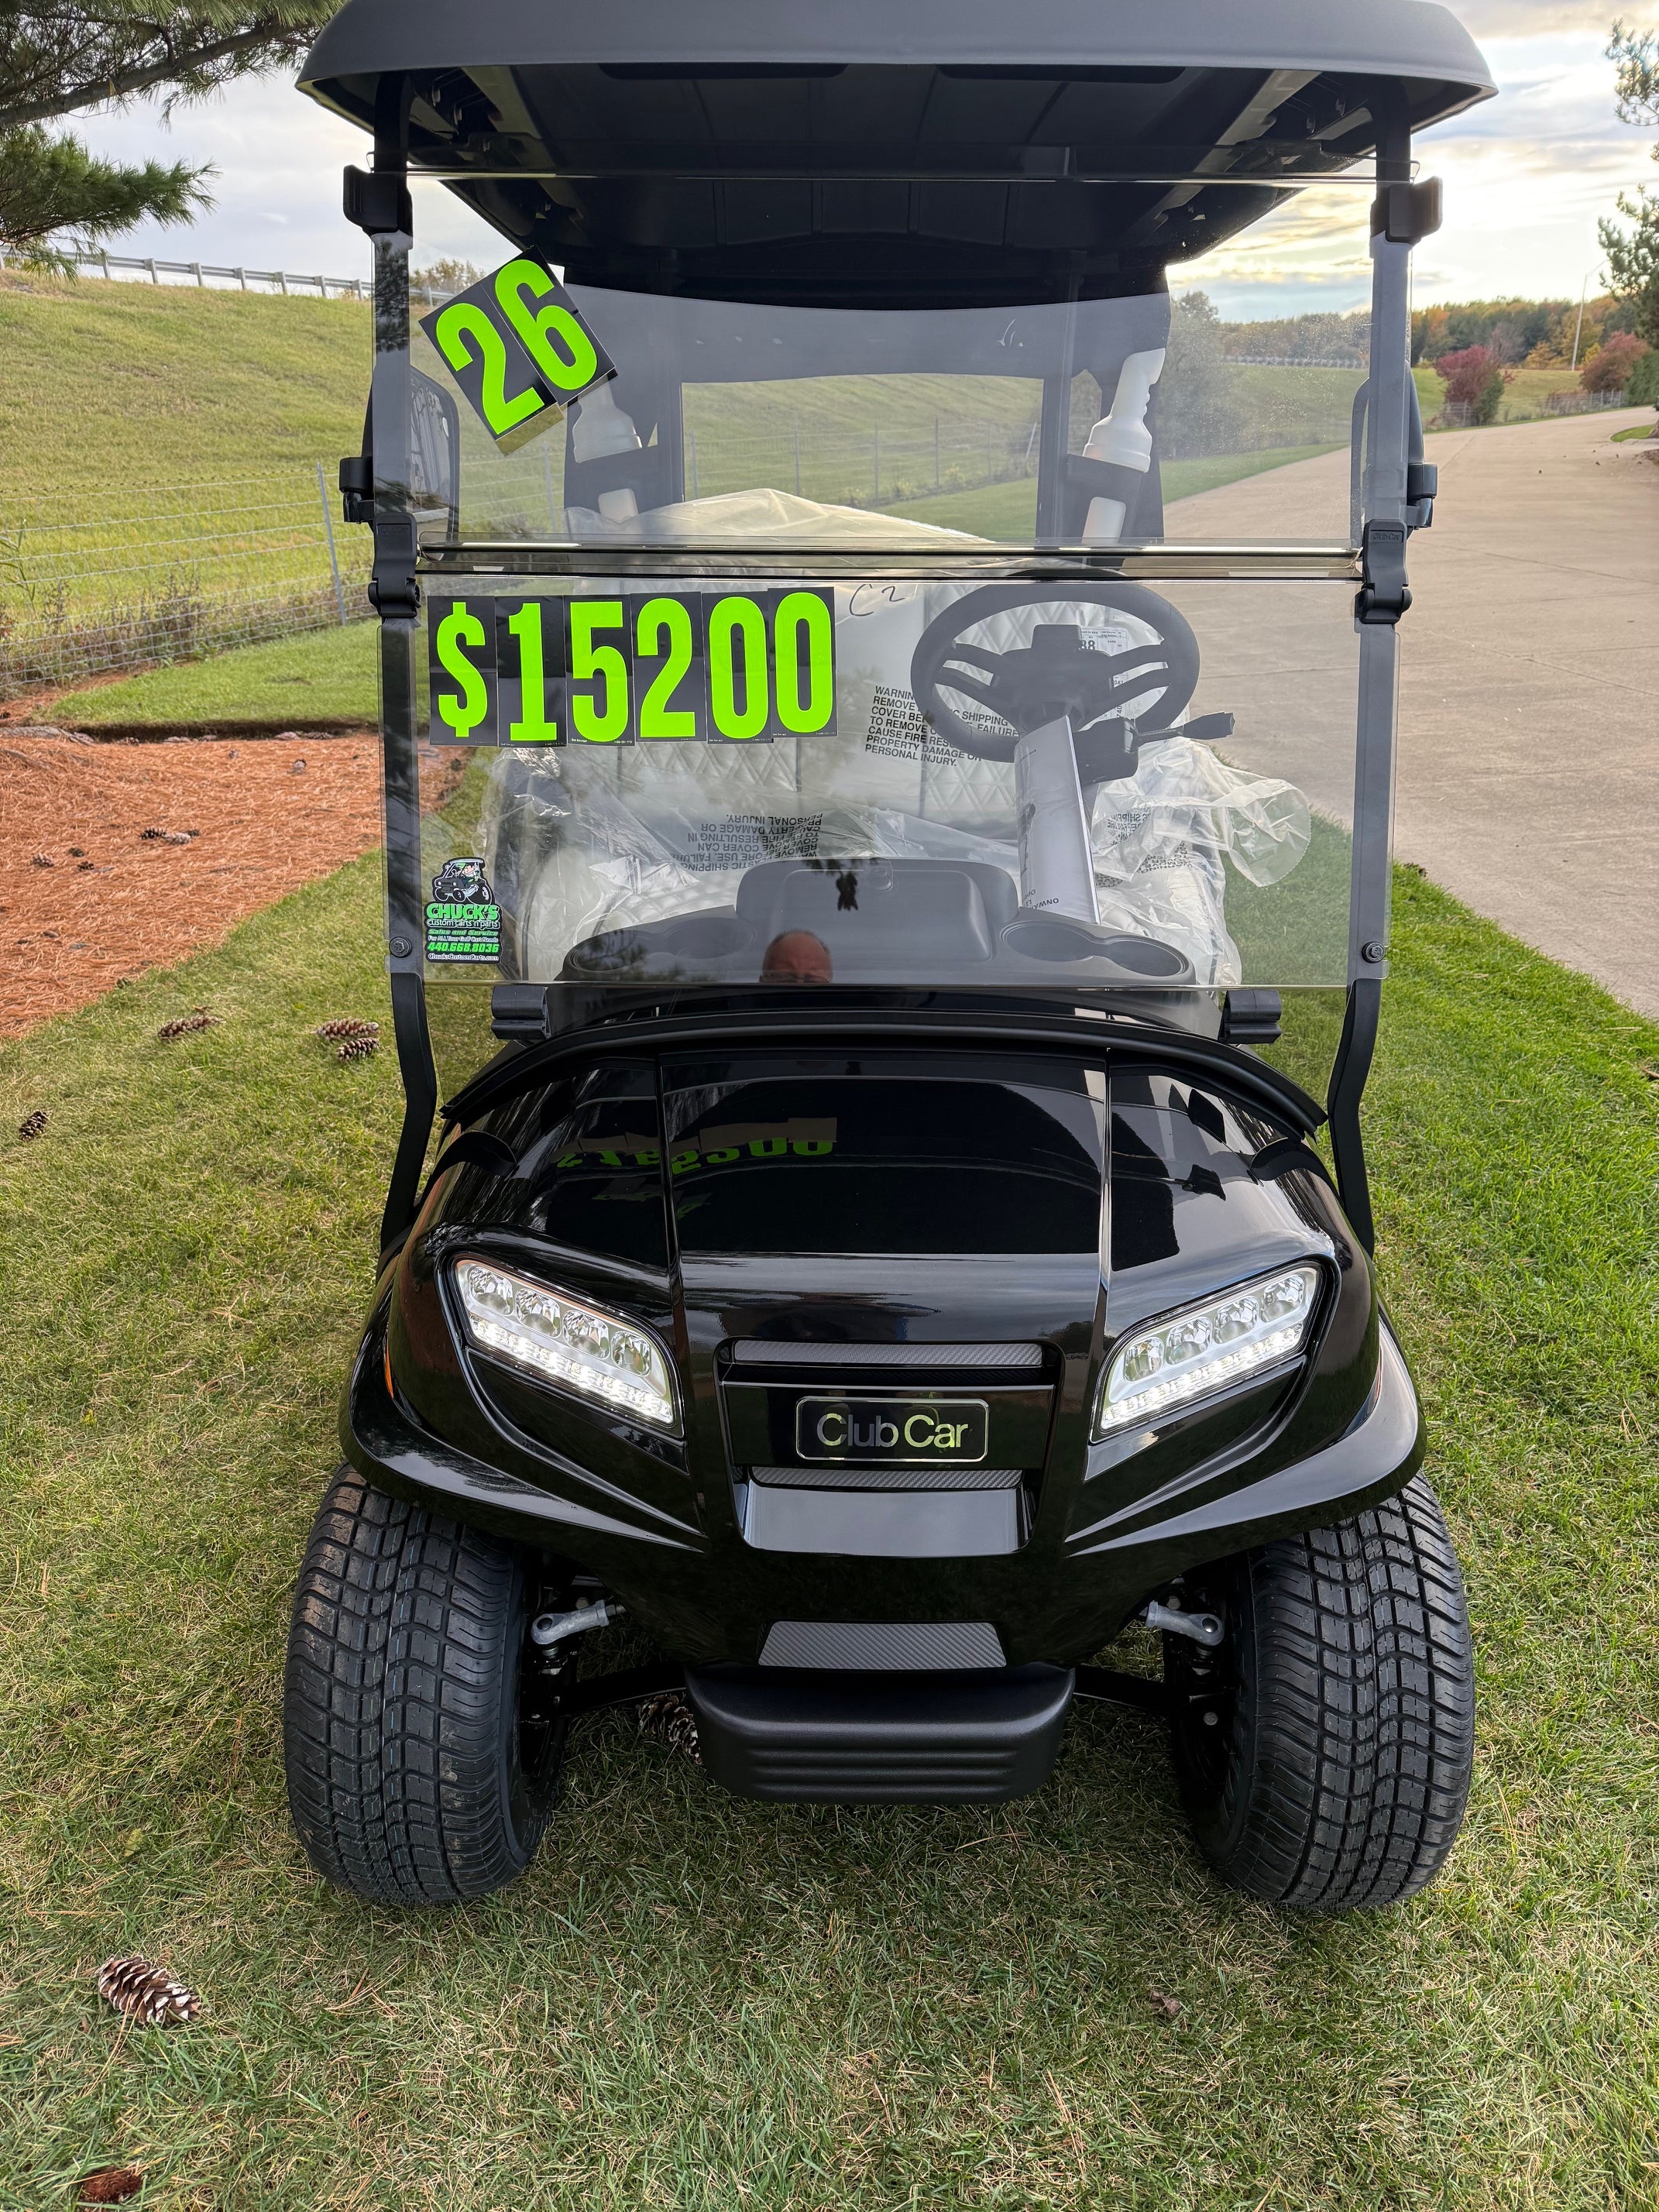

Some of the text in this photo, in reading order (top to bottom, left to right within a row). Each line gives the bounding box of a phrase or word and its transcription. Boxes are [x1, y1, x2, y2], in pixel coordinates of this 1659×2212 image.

[436, 259, 597, 435] 26
[436, 592, 833, 742] $15200
[875, 686, 915, 701] WARNIN
[871, 706, 907, 720] COVER
[873, 696, 915, 711] REMOVE
[961, 711, 1008, 726] SHIPPING
[871, 716, 883, 726] TO
[885, 719, 928, 733] REMOVE
[868, 726, 902, 740] CAUSE
[904, 732, 927, 744] FIRE
[867, 734, 920, 750] PROPERTY
[922, 745, 965, 759] DAMAGE
[865, 744, 957, 767] PERSONAL INJURY.
[726, 814, 765, 824] INJURY.
[701, 823, 717, 833] OR
[720, 824, 765, 835] DAMAGE
[688, 833, 698, 843] IN
[700, 833, 759, 843] RESULTING
[762, 835, 785, 843] FIRE
[784, 838, 819, 850] COVER
[698, 843, 720, 852] CAN
[723, 843, 759, 852] COVER
[775, 844, 817, 859] REMOVE
[715, 853, 738, 862] USE.
[681, 862, 729, 872] SHIPPING
[426, 903, 500, 920] CHUCK'S
[427, 942, 500, 953] 440.668.8036
[817, 1413, 968, 1448] Club Car
